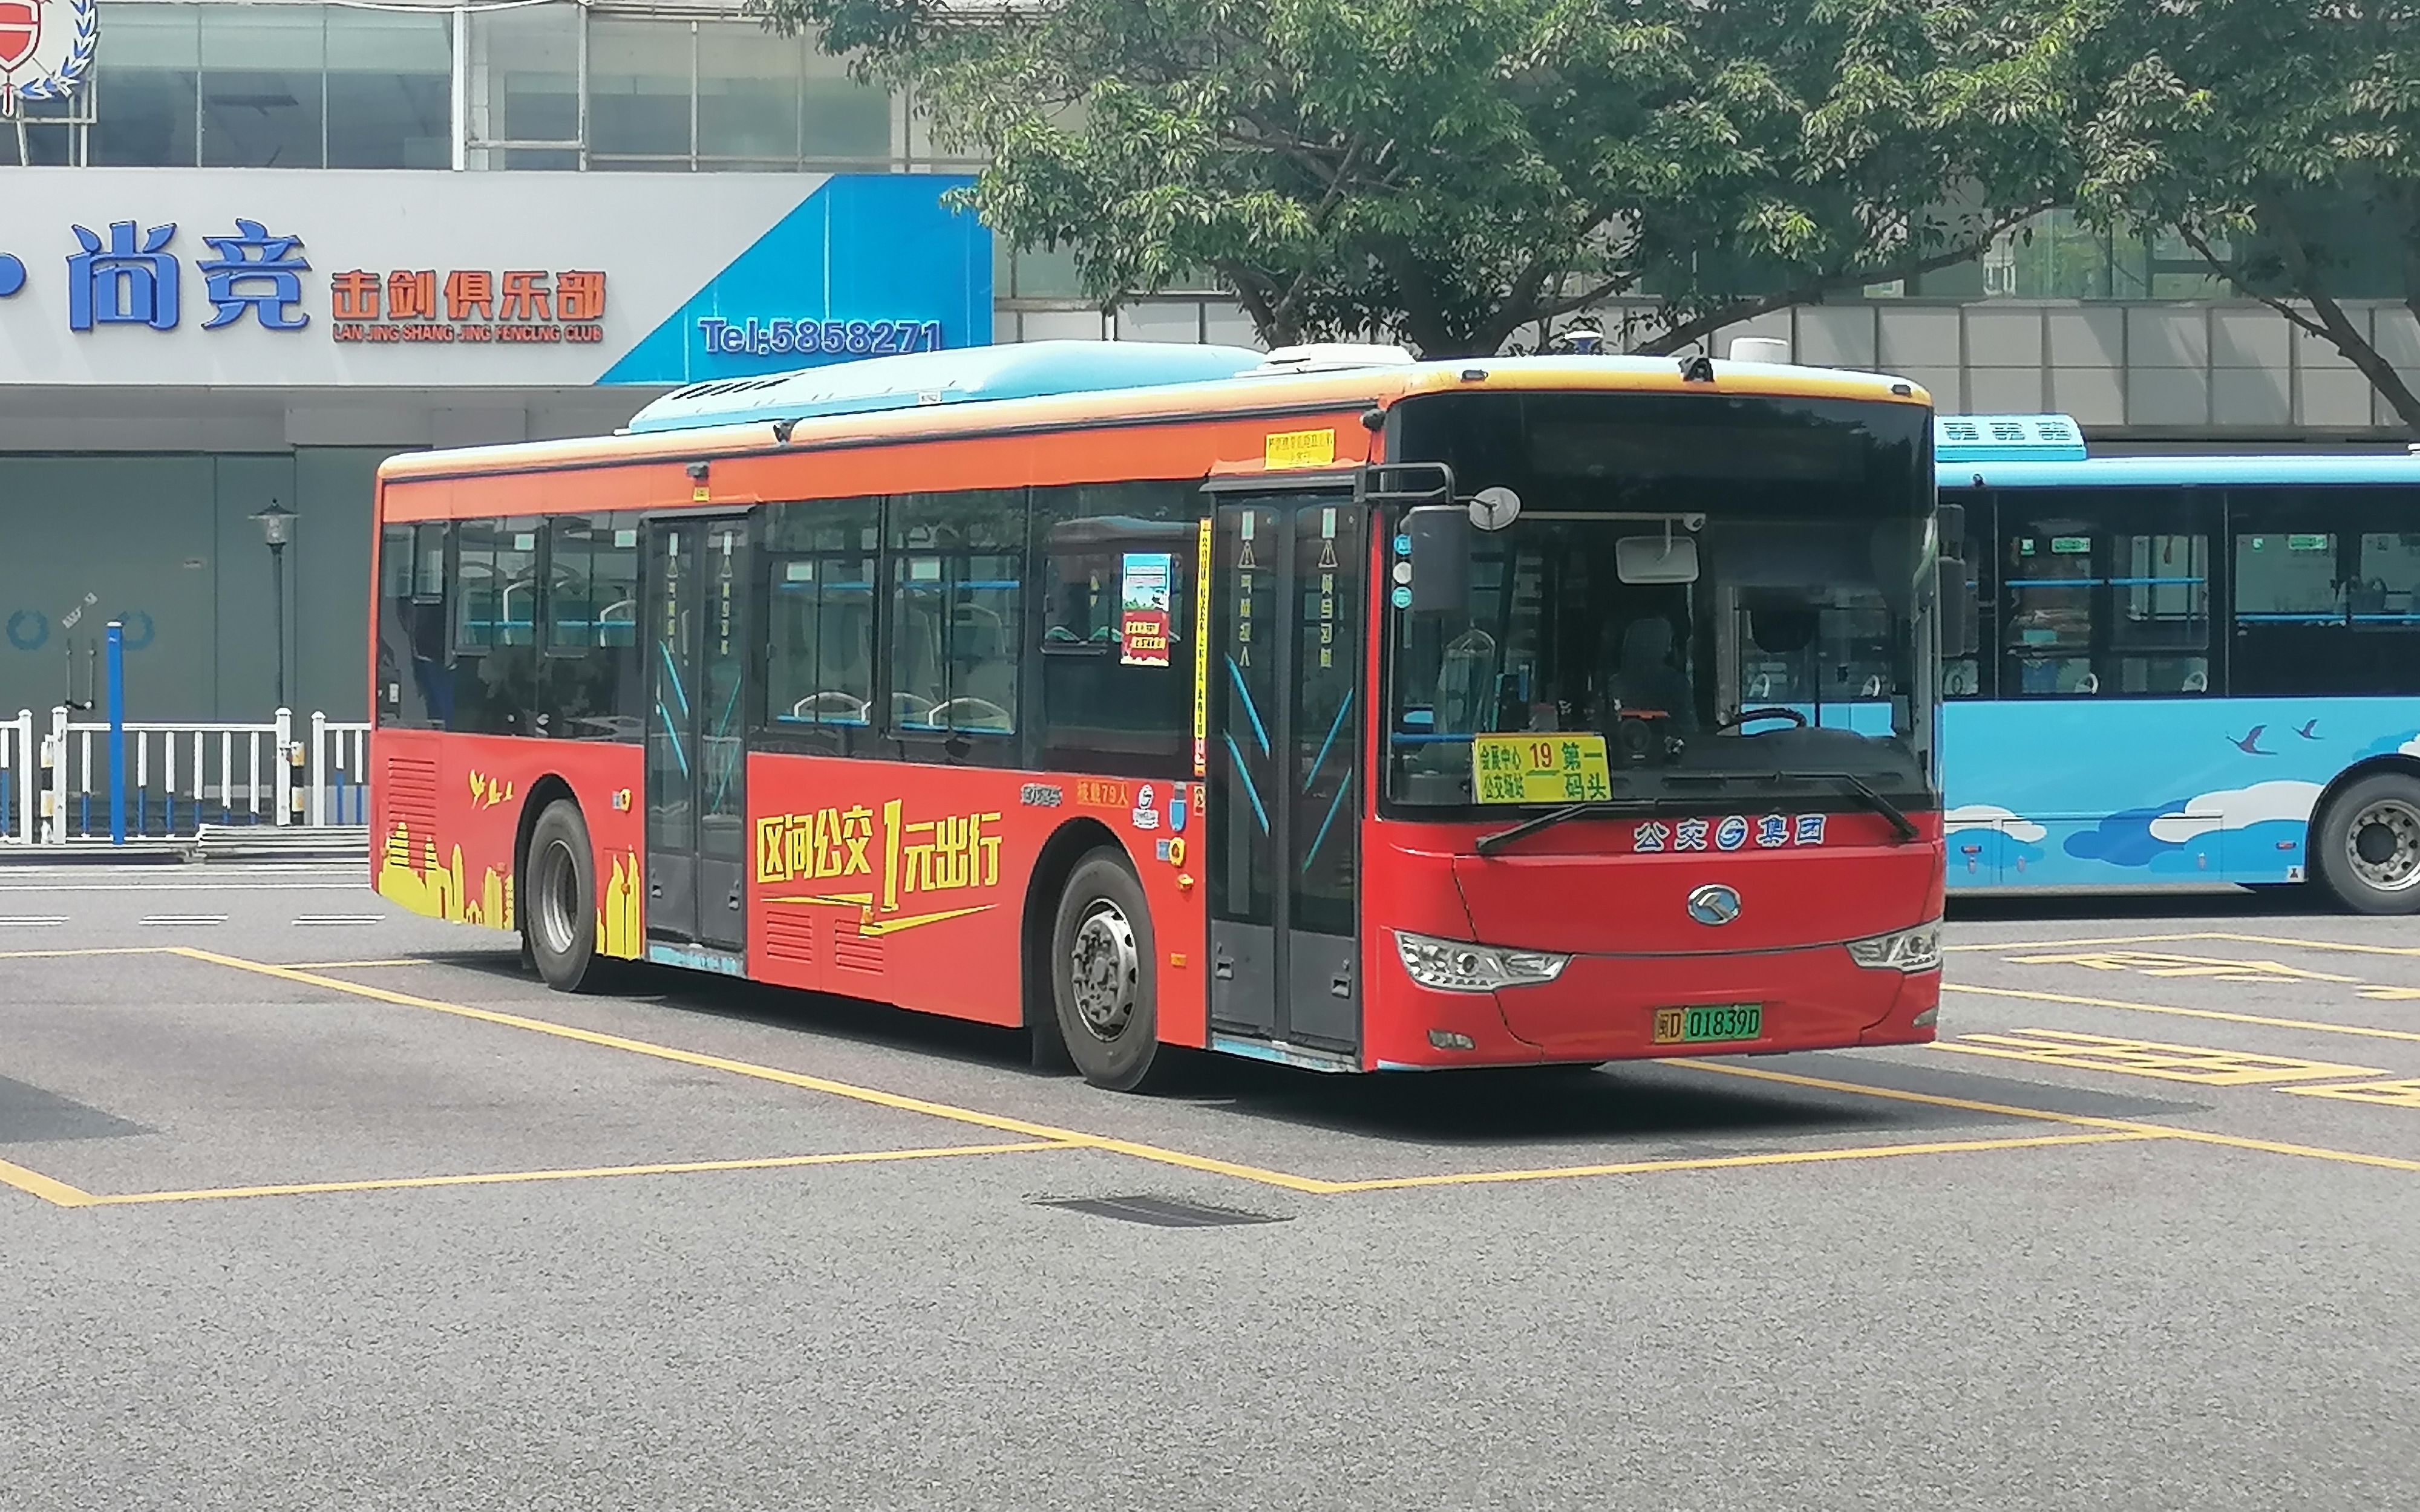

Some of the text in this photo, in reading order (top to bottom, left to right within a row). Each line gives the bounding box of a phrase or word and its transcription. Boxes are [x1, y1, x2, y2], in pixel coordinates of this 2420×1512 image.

[65, 218, 312, 333] 尚竞
[332, 269, 607, 321] 击剑俱乐部
[332, 324, 364, 343] LAN
[365, 324, 400, 343] JING
[402, 324, 454, 343] SHANG
[457, 324, 492, 343] JING
[563, 324, 604, 343] CLUB
[698, 316, 941, 355] Tel:5858271
[1529, 742, 1553, 768] 19
[1561, 741, 1603, 771] 第一
[1563, 772, 1607, 800] 码头
